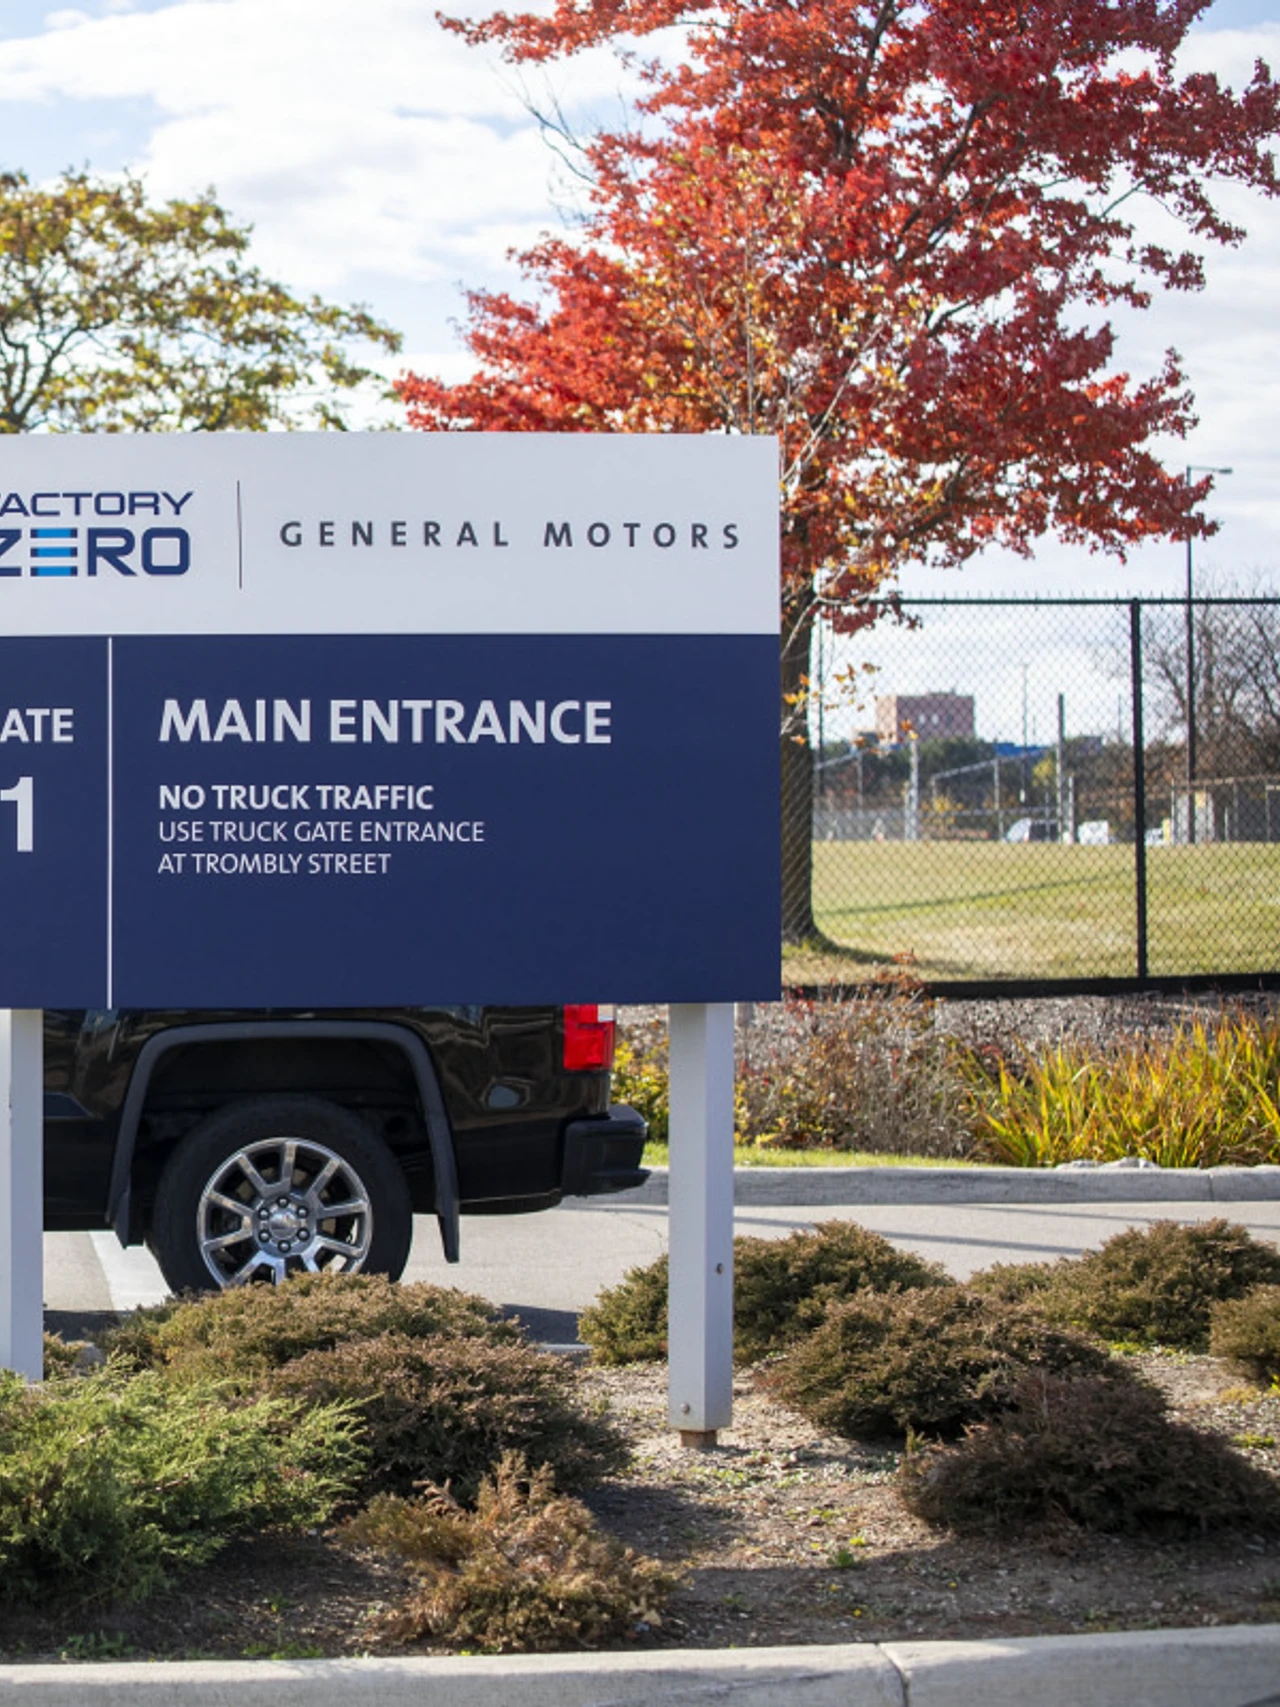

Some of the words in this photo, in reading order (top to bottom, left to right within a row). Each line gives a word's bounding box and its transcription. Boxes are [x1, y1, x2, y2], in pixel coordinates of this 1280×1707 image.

[279, 520, 509, 548] GENERAL
[543, 522, 739, 550] MOTORS
[159, 699, 311, 742] MAIN
[330, 699, 612, 744] ENTRANCE
[159, 785, 206, 810] NO
[211, 785, 310, 810] TRUCK
[315, 785, 433, 810] TRAFFIC
[0, 776, 34, 852] 1
[159, 821, 204, 842] USE
[208, 821, 288, 842] TRUCK
[294, 821, 353, 842] GATE
[360, 821, 484, 842] ENTRANCE
[157, 853, 187, 874] AT
[191, 853, 303, 874] TROMBLY
[308, 853, 392, 874] STREET
